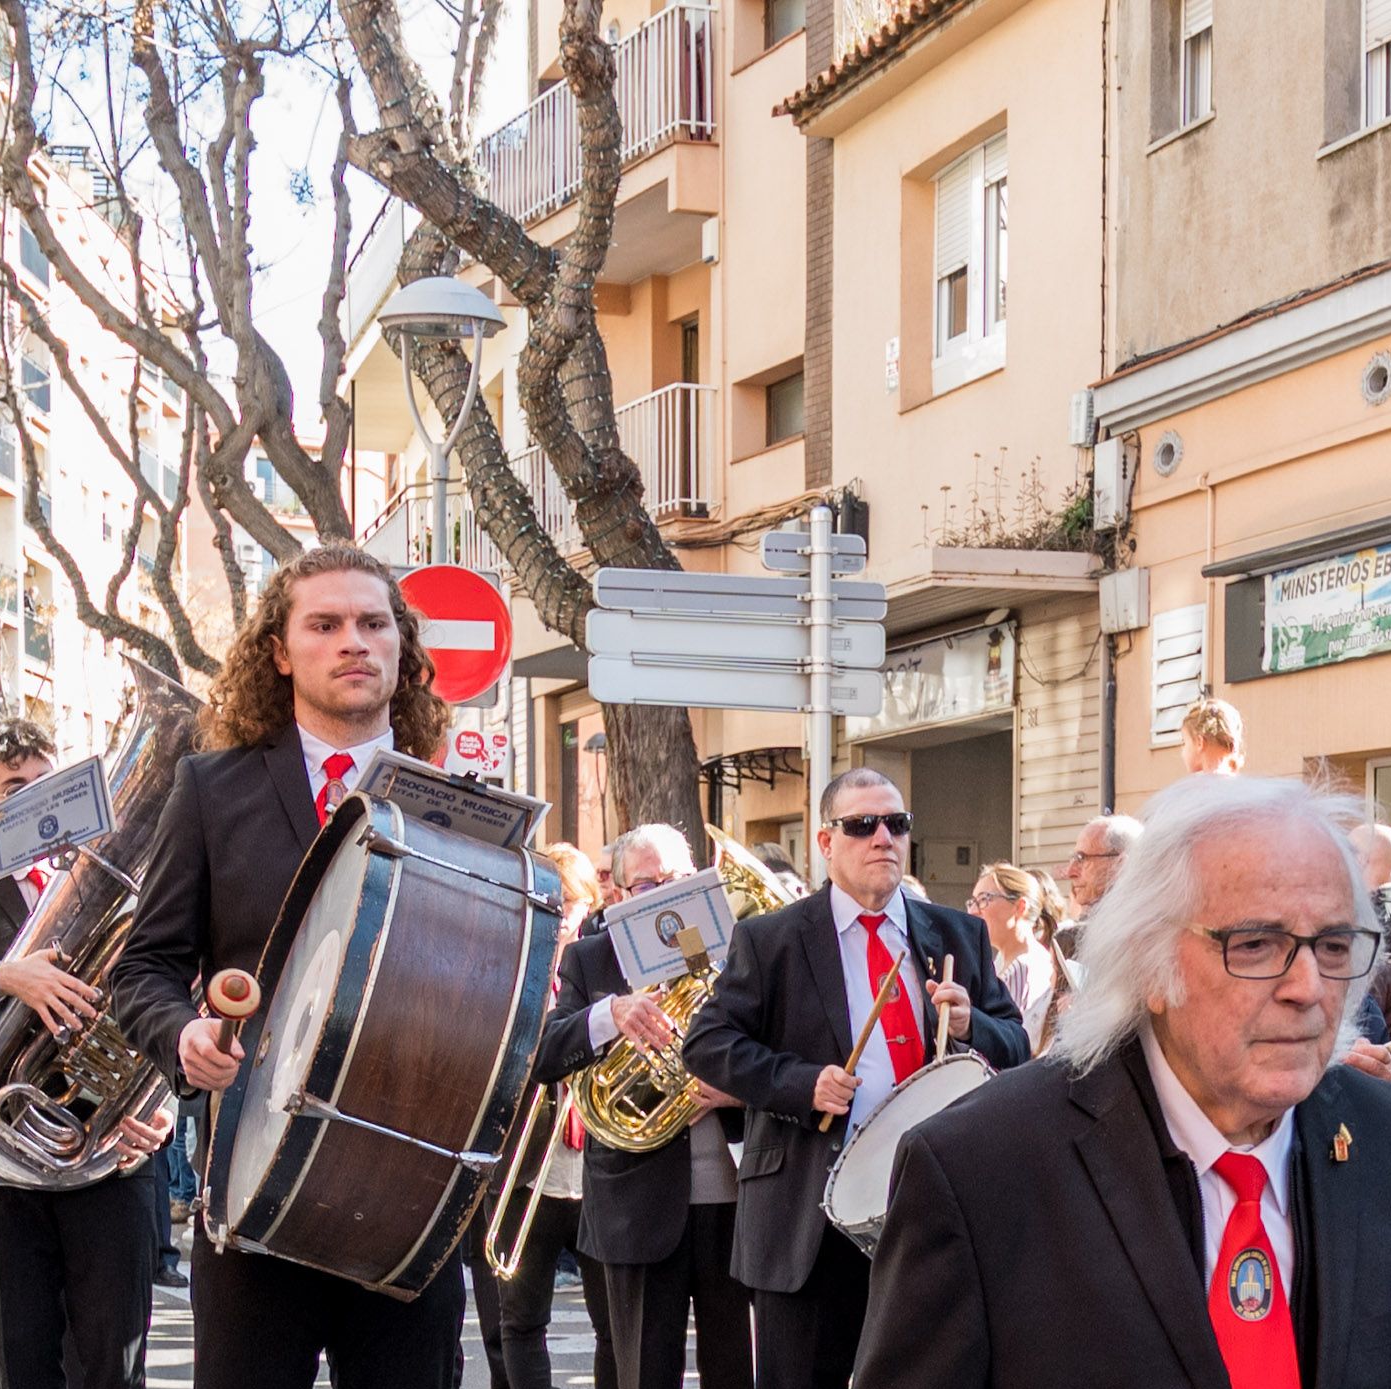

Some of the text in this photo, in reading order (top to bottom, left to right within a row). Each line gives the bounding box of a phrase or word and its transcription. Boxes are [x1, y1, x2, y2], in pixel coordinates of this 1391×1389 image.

[1280, 557, 1370, 603] MINISTERIOS
[1327, 639, 1346, 659] por
[51, 781, 90, 802] MUSICAL
[426, 798, 442, 808] DE
[447, 804, 466, 816] LES
[471, 814, 506, 827] ROSES
[461, 798, 514, 823] MUSICAL
